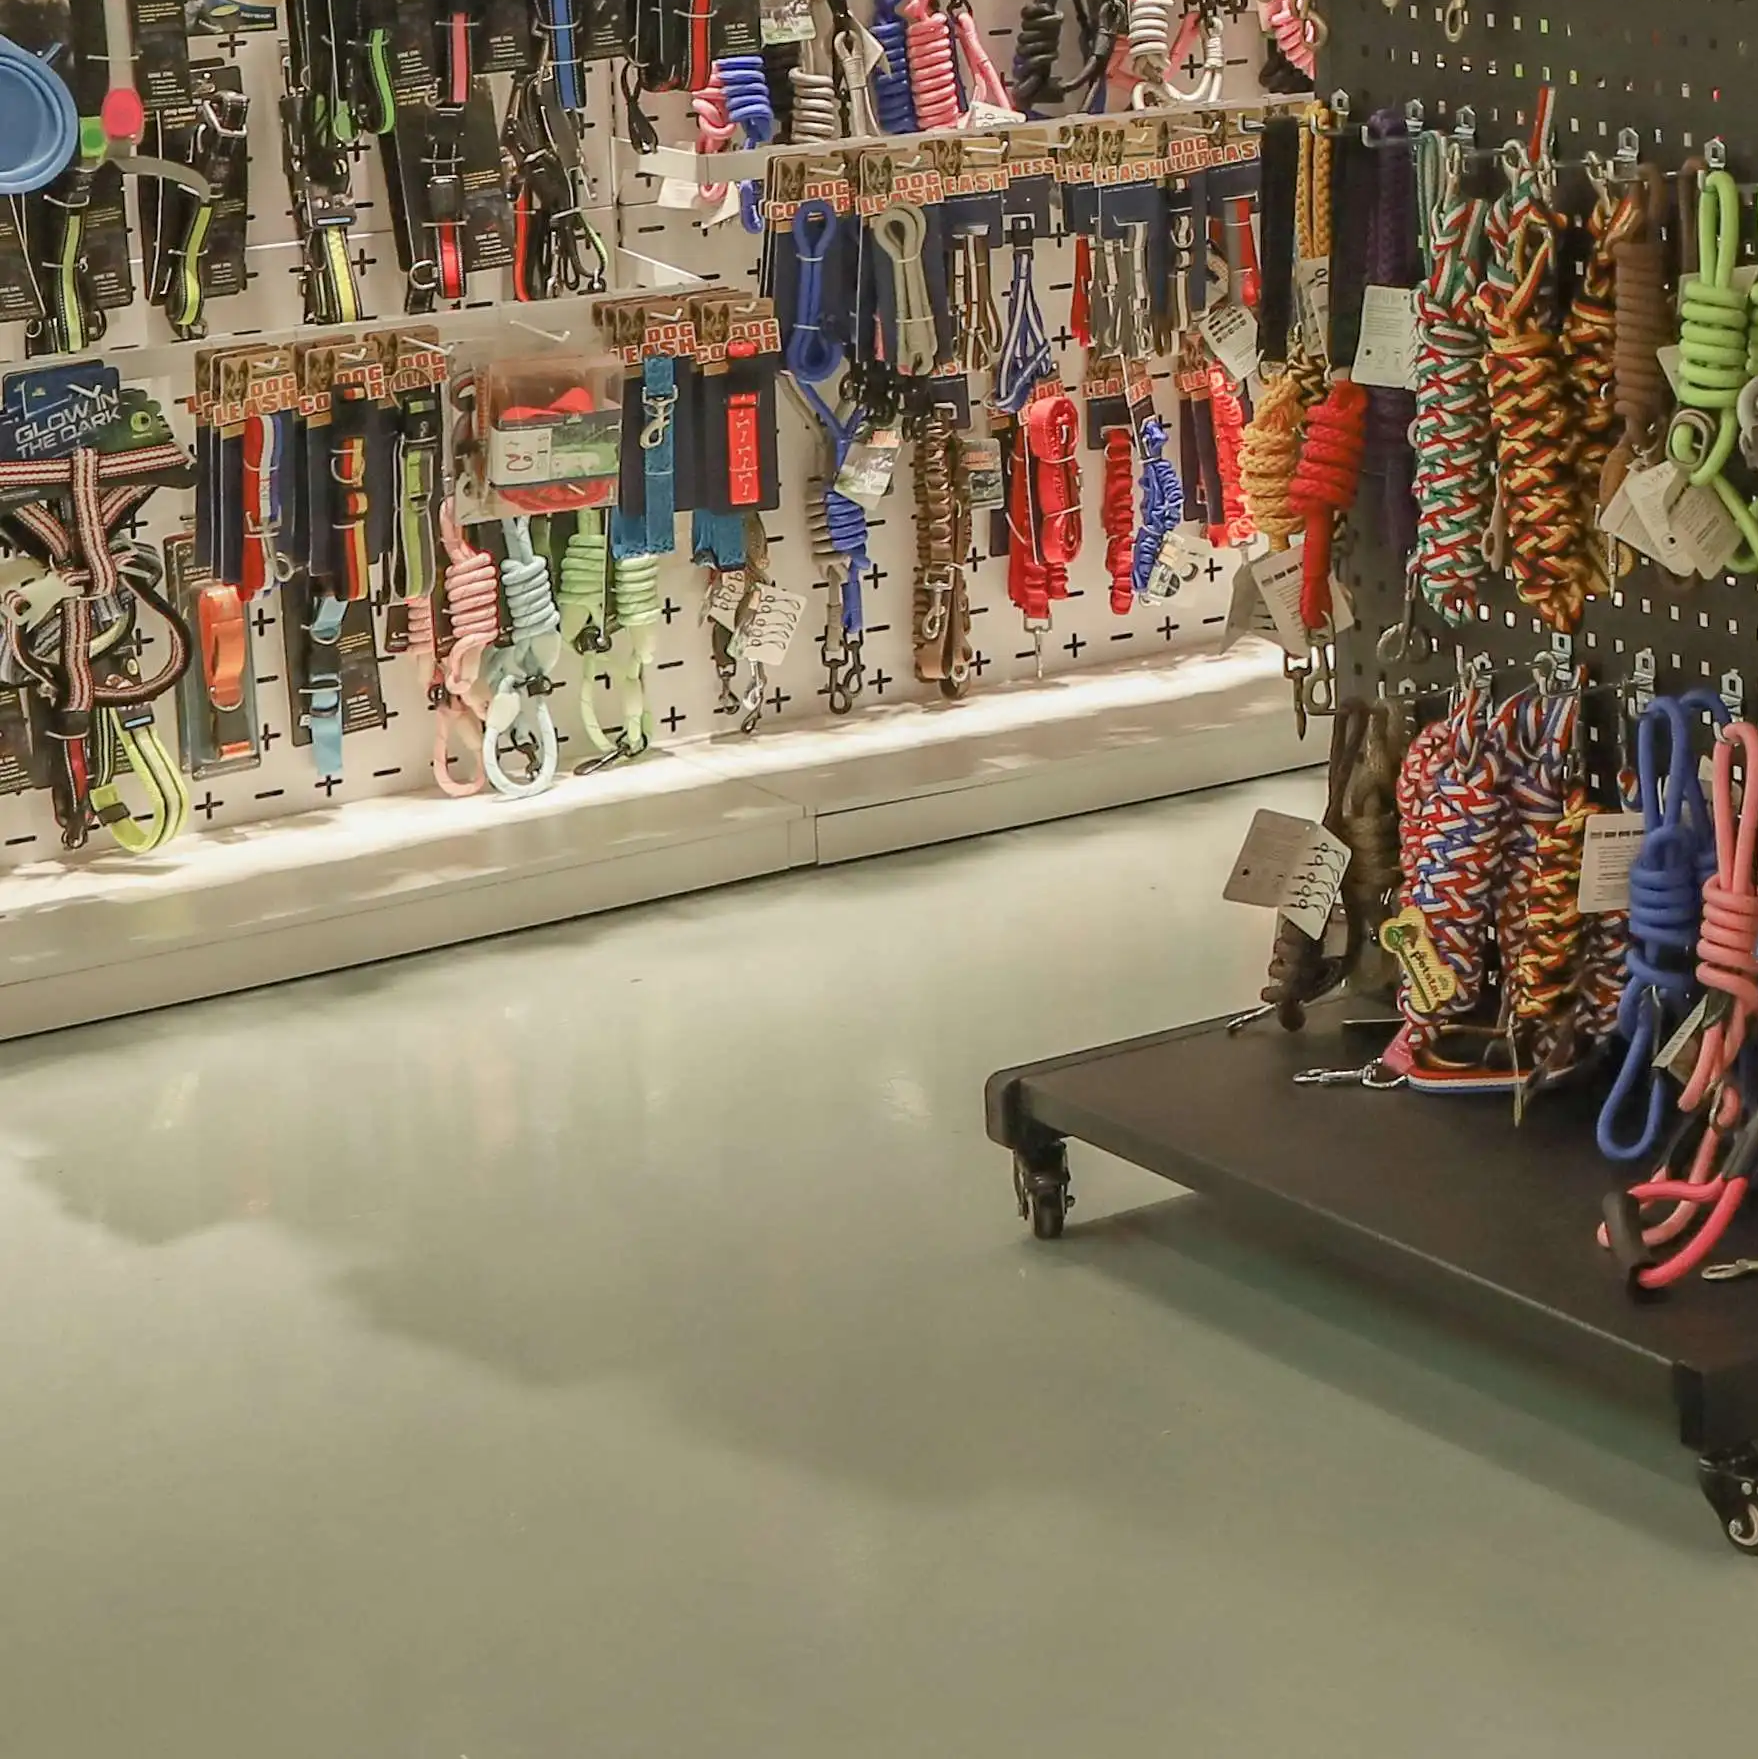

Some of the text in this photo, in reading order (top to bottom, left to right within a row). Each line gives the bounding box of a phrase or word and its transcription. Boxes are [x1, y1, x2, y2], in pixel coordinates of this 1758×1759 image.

[1096, 160, 1162, 184] LEASH
[622, 336, 697, 365] EASH
[250, 373, 297, 393] DOG
[15, 389, 120, 445] GLOW IN
[213, 390, 299, 427] LEASH
[17, 405, 121, 458] THE DARK
